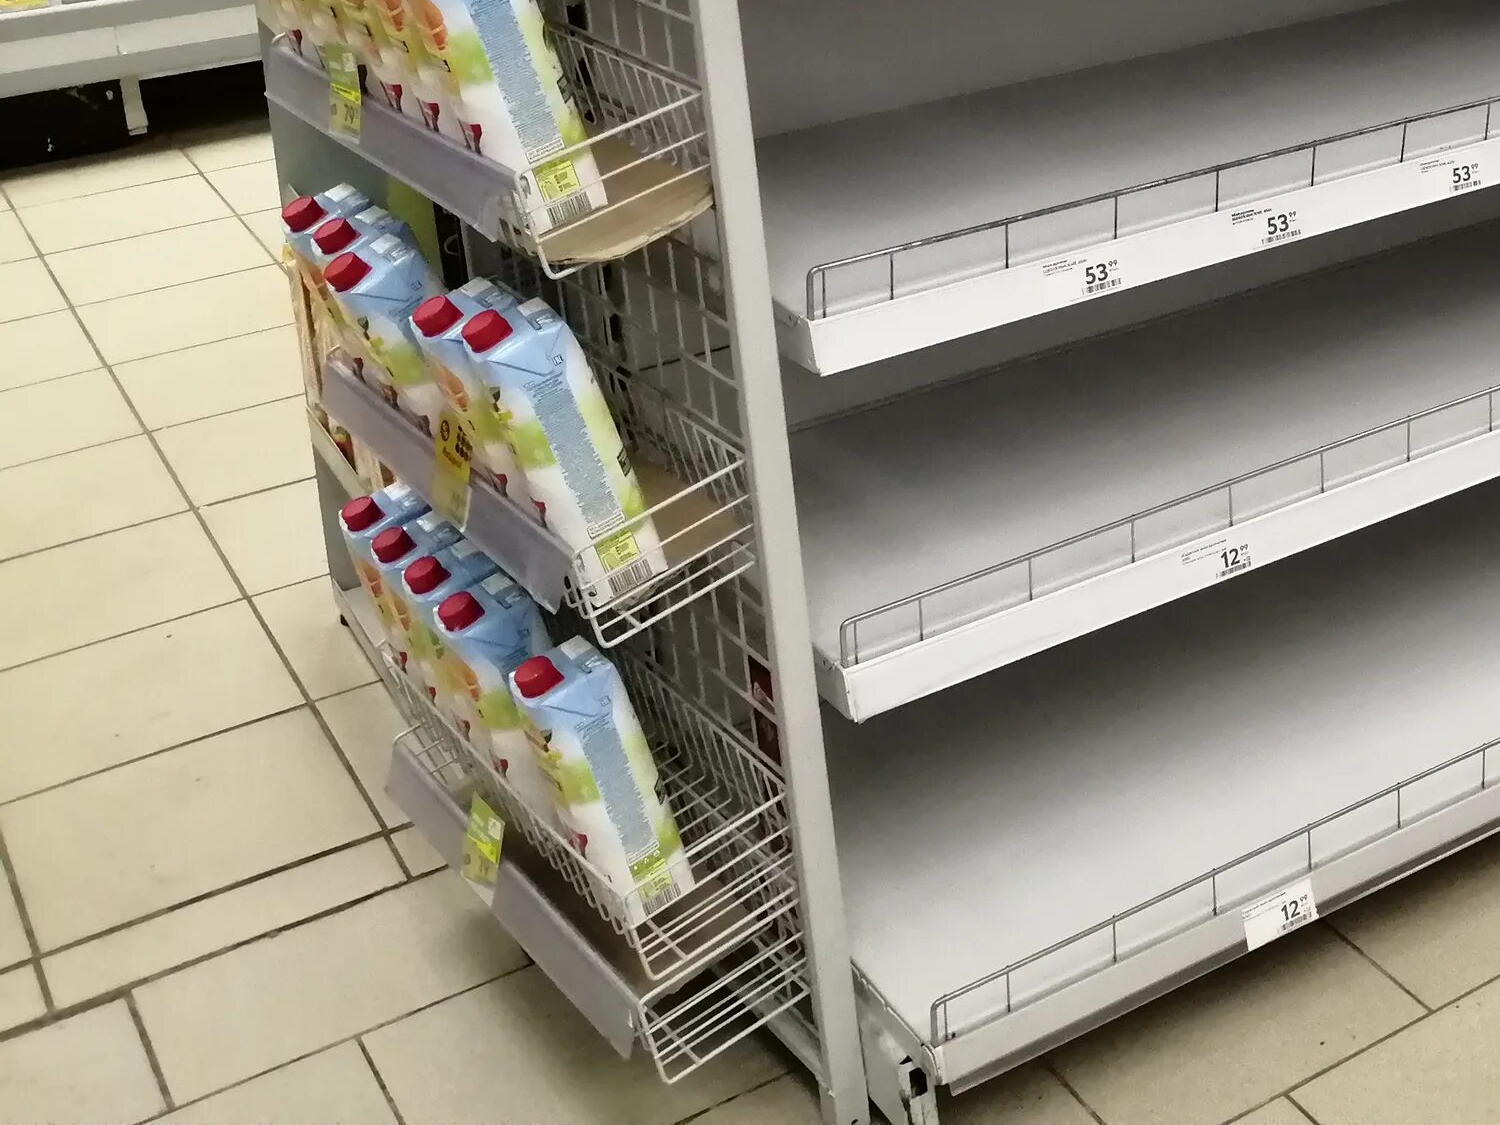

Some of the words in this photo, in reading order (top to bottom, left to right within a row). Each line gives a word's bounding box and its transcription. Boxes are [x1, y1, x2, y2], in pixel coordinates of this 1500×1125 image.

[1452, 165, 1471, 184] 53
[1267, 213, 1290, 235] 53
[1288, 210, 1297, 218] 99
[1085, 263, 1109, 285] 53
[1107, 259, 1118, 267] 99
[1221, 547, 1241, 568] 12
[1281, 900, 1300, 921] 12
